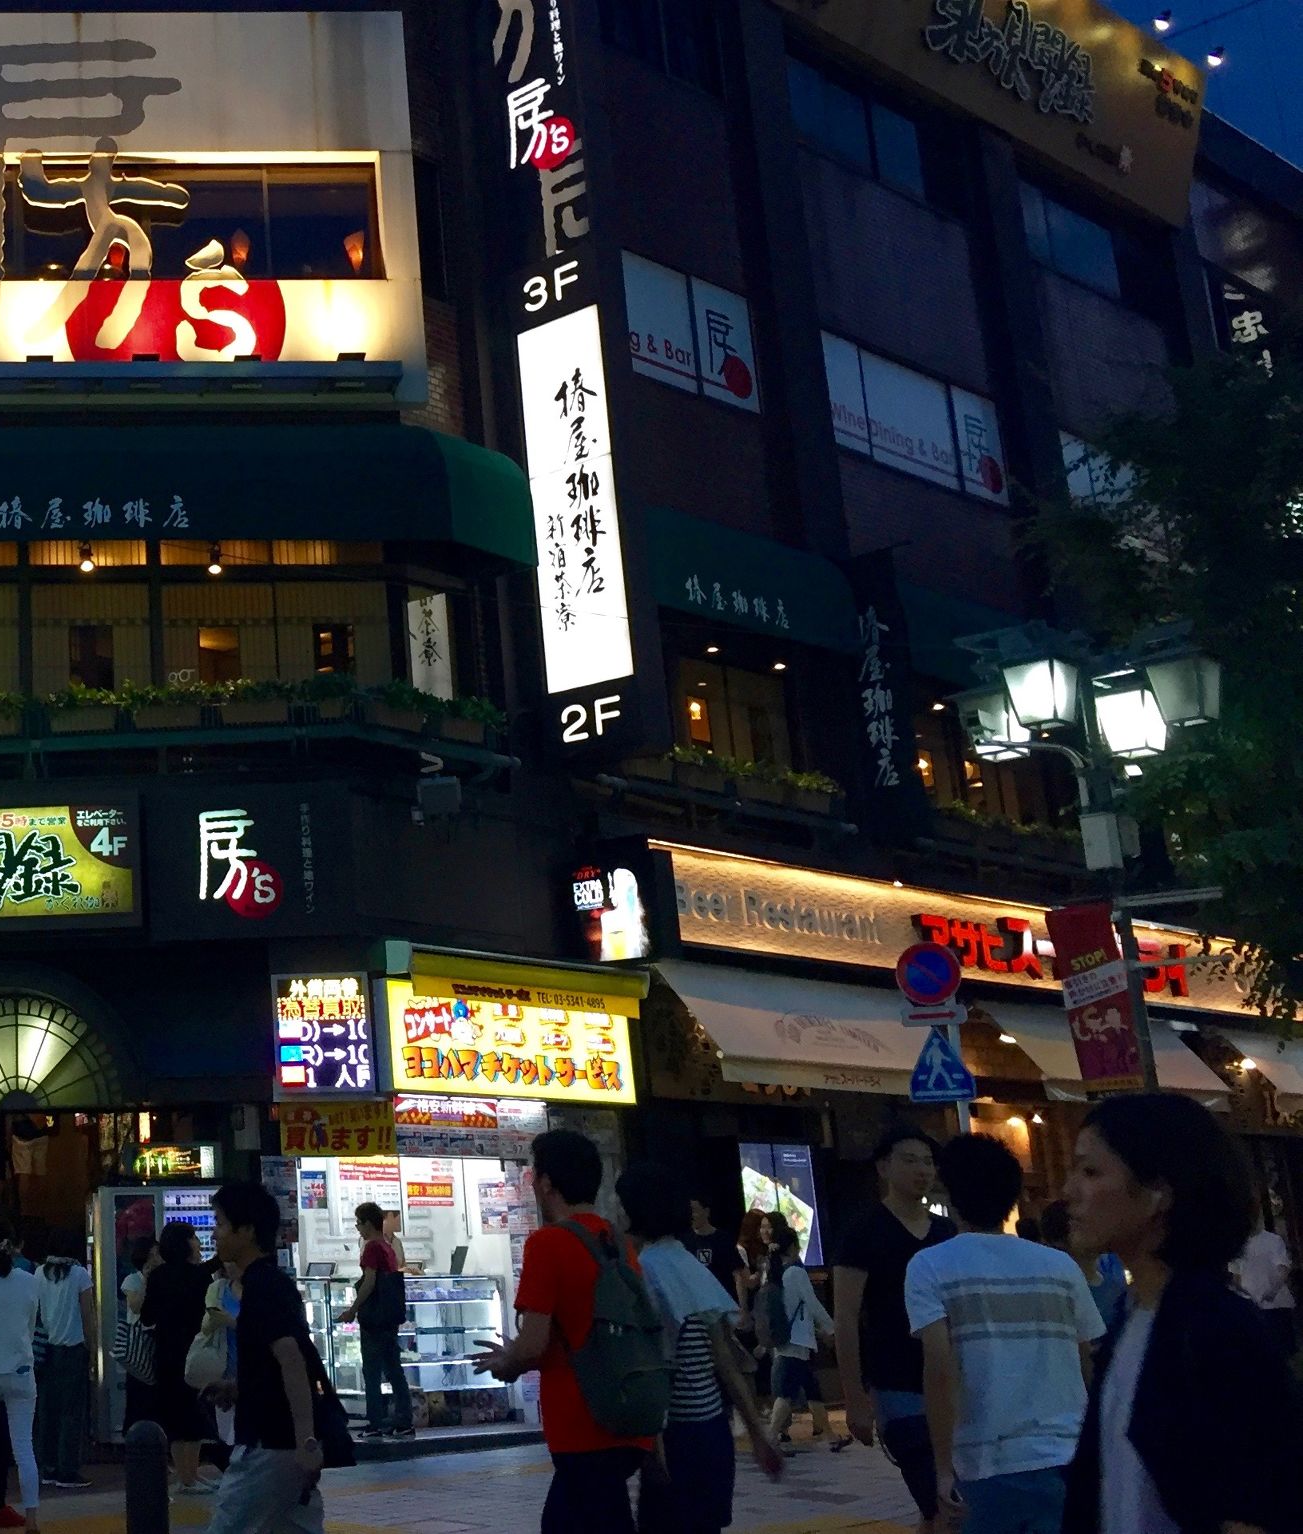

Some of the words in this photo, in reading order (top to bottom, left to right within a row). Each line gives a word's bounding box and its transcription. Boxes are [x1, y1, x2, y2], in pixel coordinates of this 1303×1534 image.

[523, 260, 579, 312] 3F
[664, 337, 693, 367] Bar
[560, 696, 622, 744] 2F
[76, 808, 124, 819] エレベーター
[90, 827, 128, 857] 4F
[573, 879, 604, 893] EXTRA
[574, 890, 604, 906] COLD
[675, 879, 733, 922] Beer
[742, 886, 882, 944] Restaurant
[405, 1005, 452, 1038] コンサート
